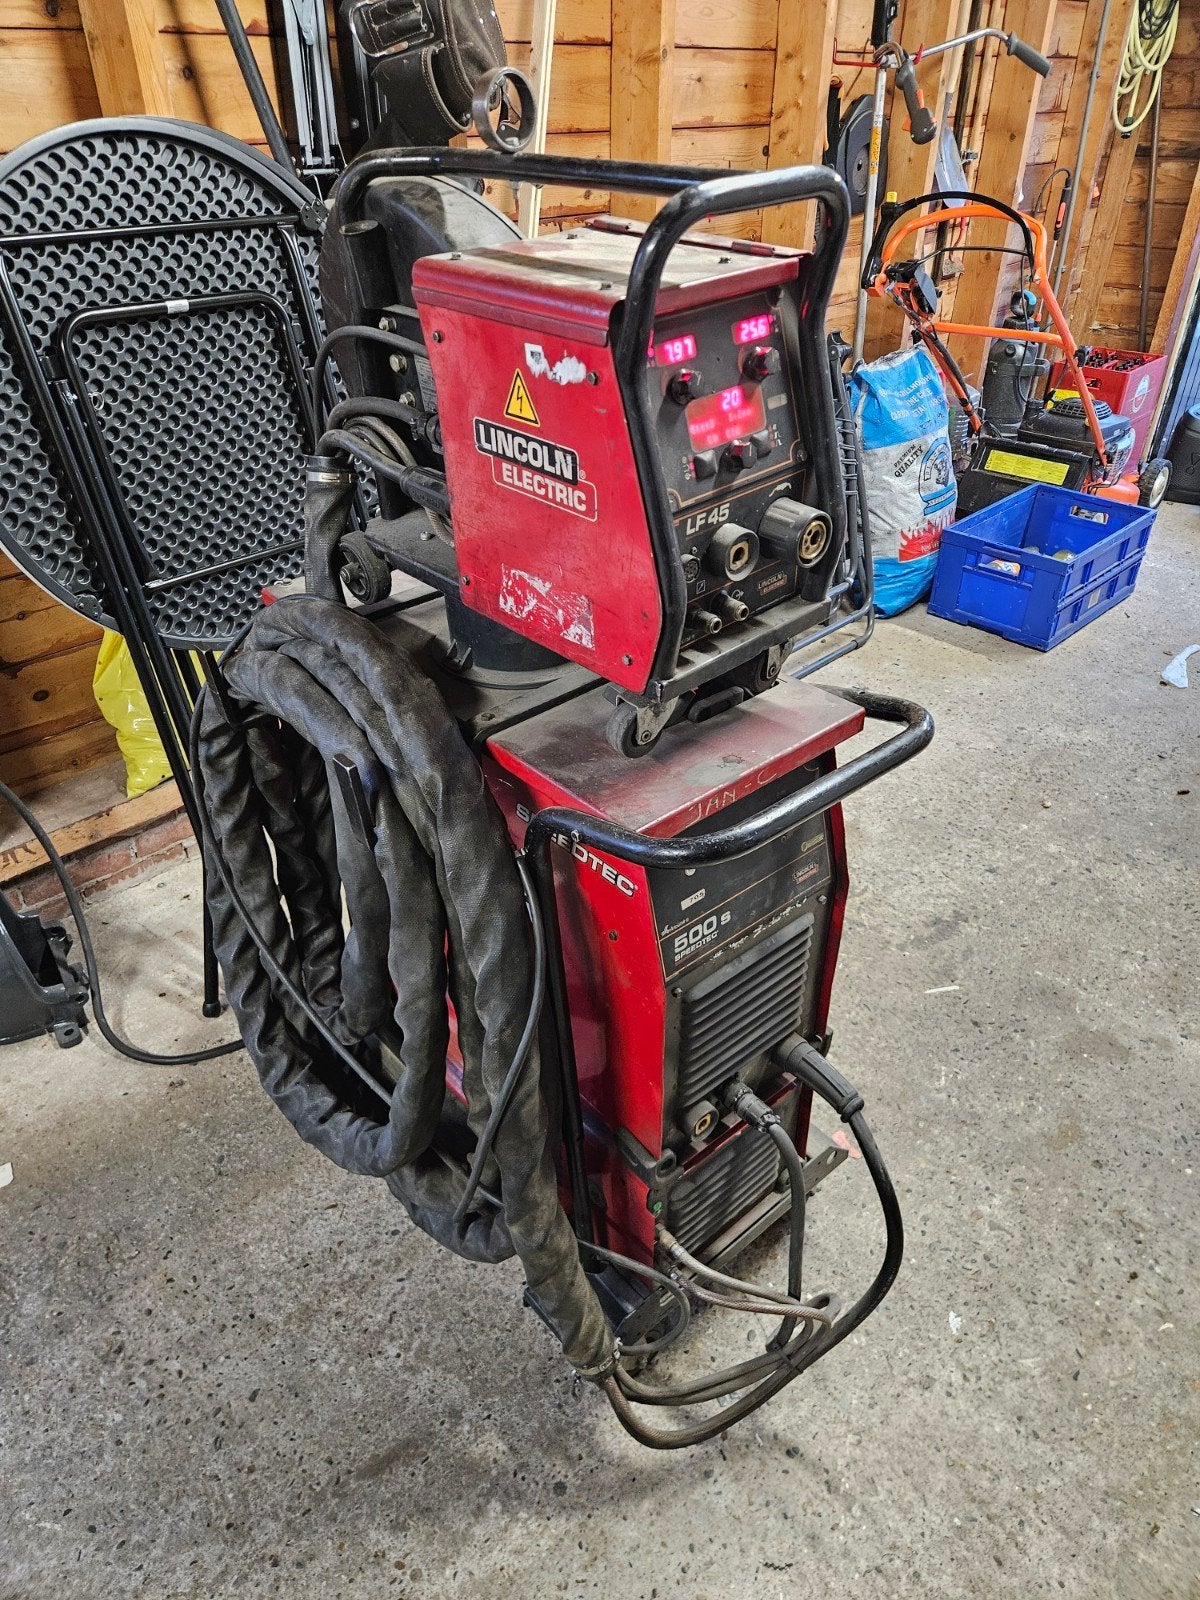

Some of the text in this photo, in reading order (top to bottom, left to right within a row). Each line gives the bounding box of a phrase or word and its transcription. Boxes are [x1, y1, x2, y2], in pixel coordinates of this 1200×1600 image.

[721, 389, 740, 411] 20
[478, 422, 573, 481] LINCOLN
[893, 444, 916, 468] PREMIUM
[894, 446, 924, 478] QUALITY
[501, 462, 587, 512] ELECTRIC
[516, 803, 635, 898] SEDTEC
[674, 915, 718, 954] 500
